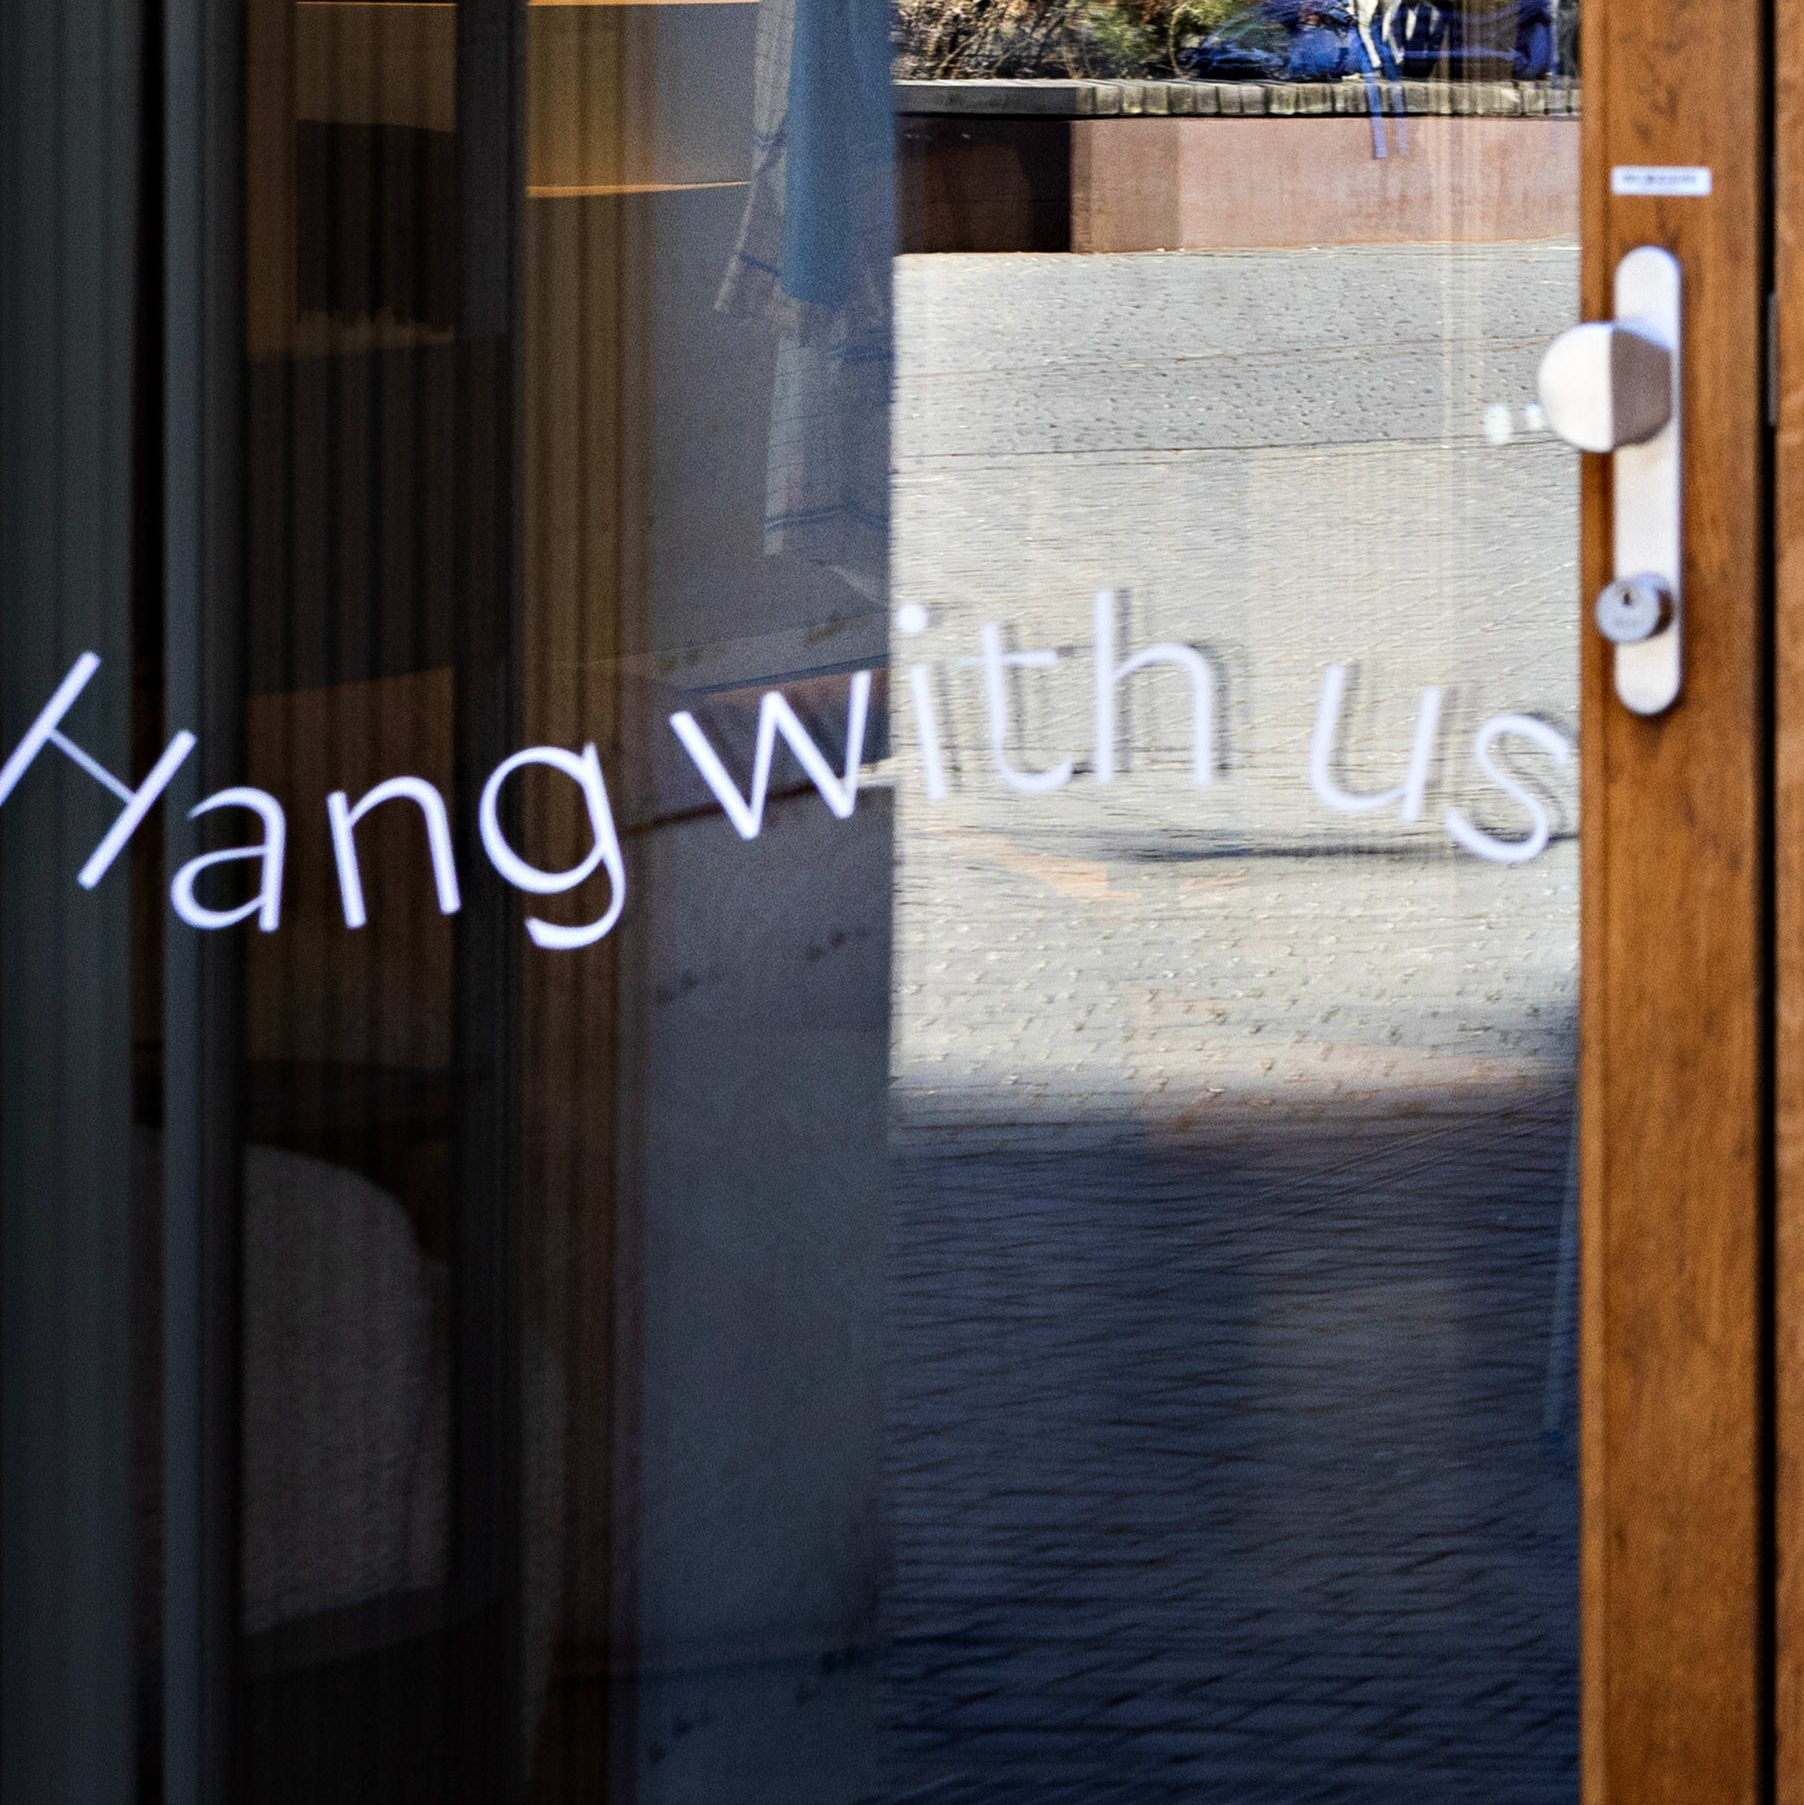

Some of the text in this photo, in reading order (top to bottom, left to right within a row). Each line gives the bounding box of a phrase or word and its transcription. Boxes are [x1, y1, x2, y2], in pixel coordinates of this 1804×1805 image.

[0, 587, 1574, 949] Hang with us
